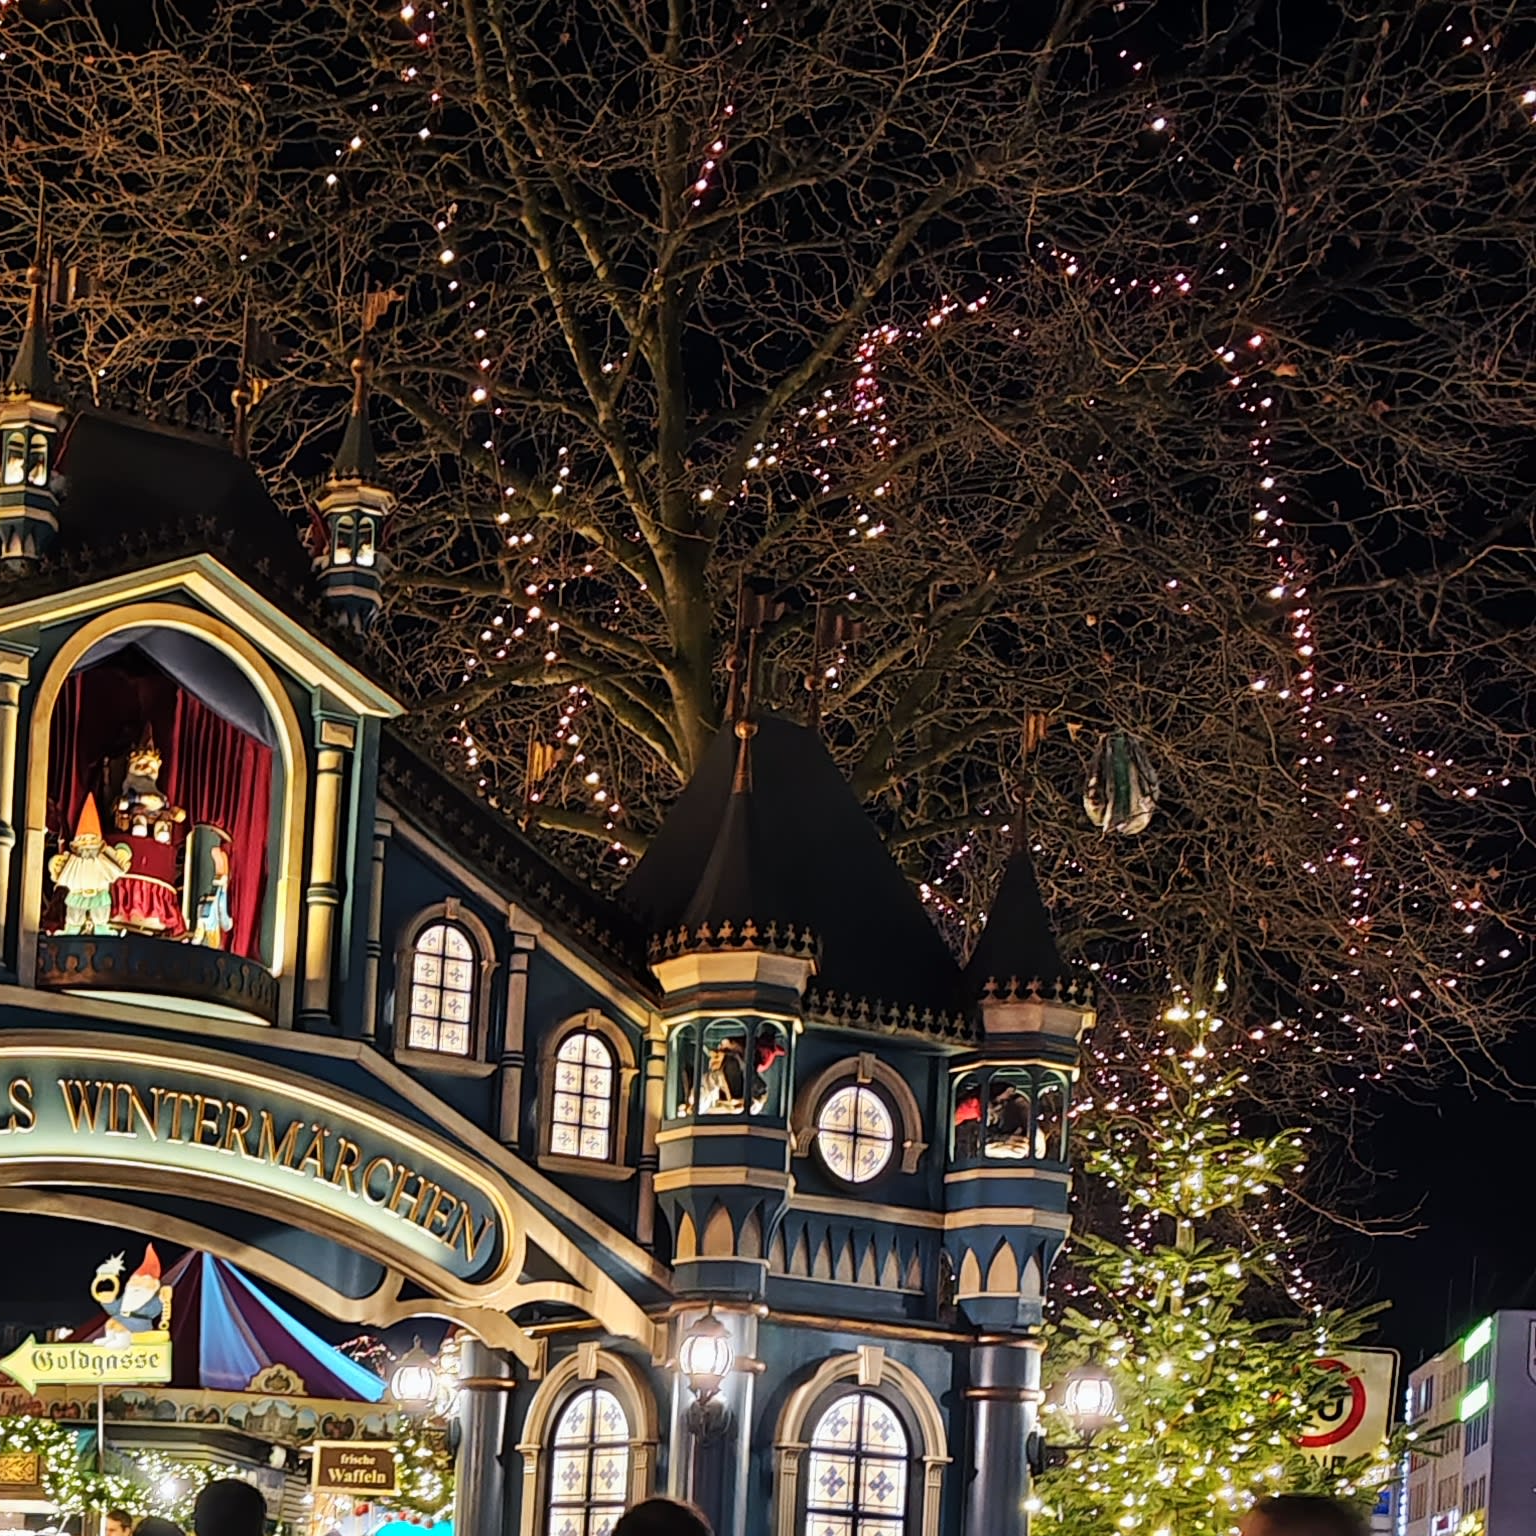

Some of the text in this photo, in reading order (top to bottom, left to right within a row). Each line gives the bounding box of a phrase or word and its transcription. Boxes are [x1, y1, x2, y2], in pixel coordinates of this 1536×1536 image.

[57, 1078, 495, 1263] WINTERMÄRCHEN
[31, 1349, 160, 1377] Goldgasse
[340, 1453, 376, 1465] frische
[328, 1467, 387, 1484] Waffeln
